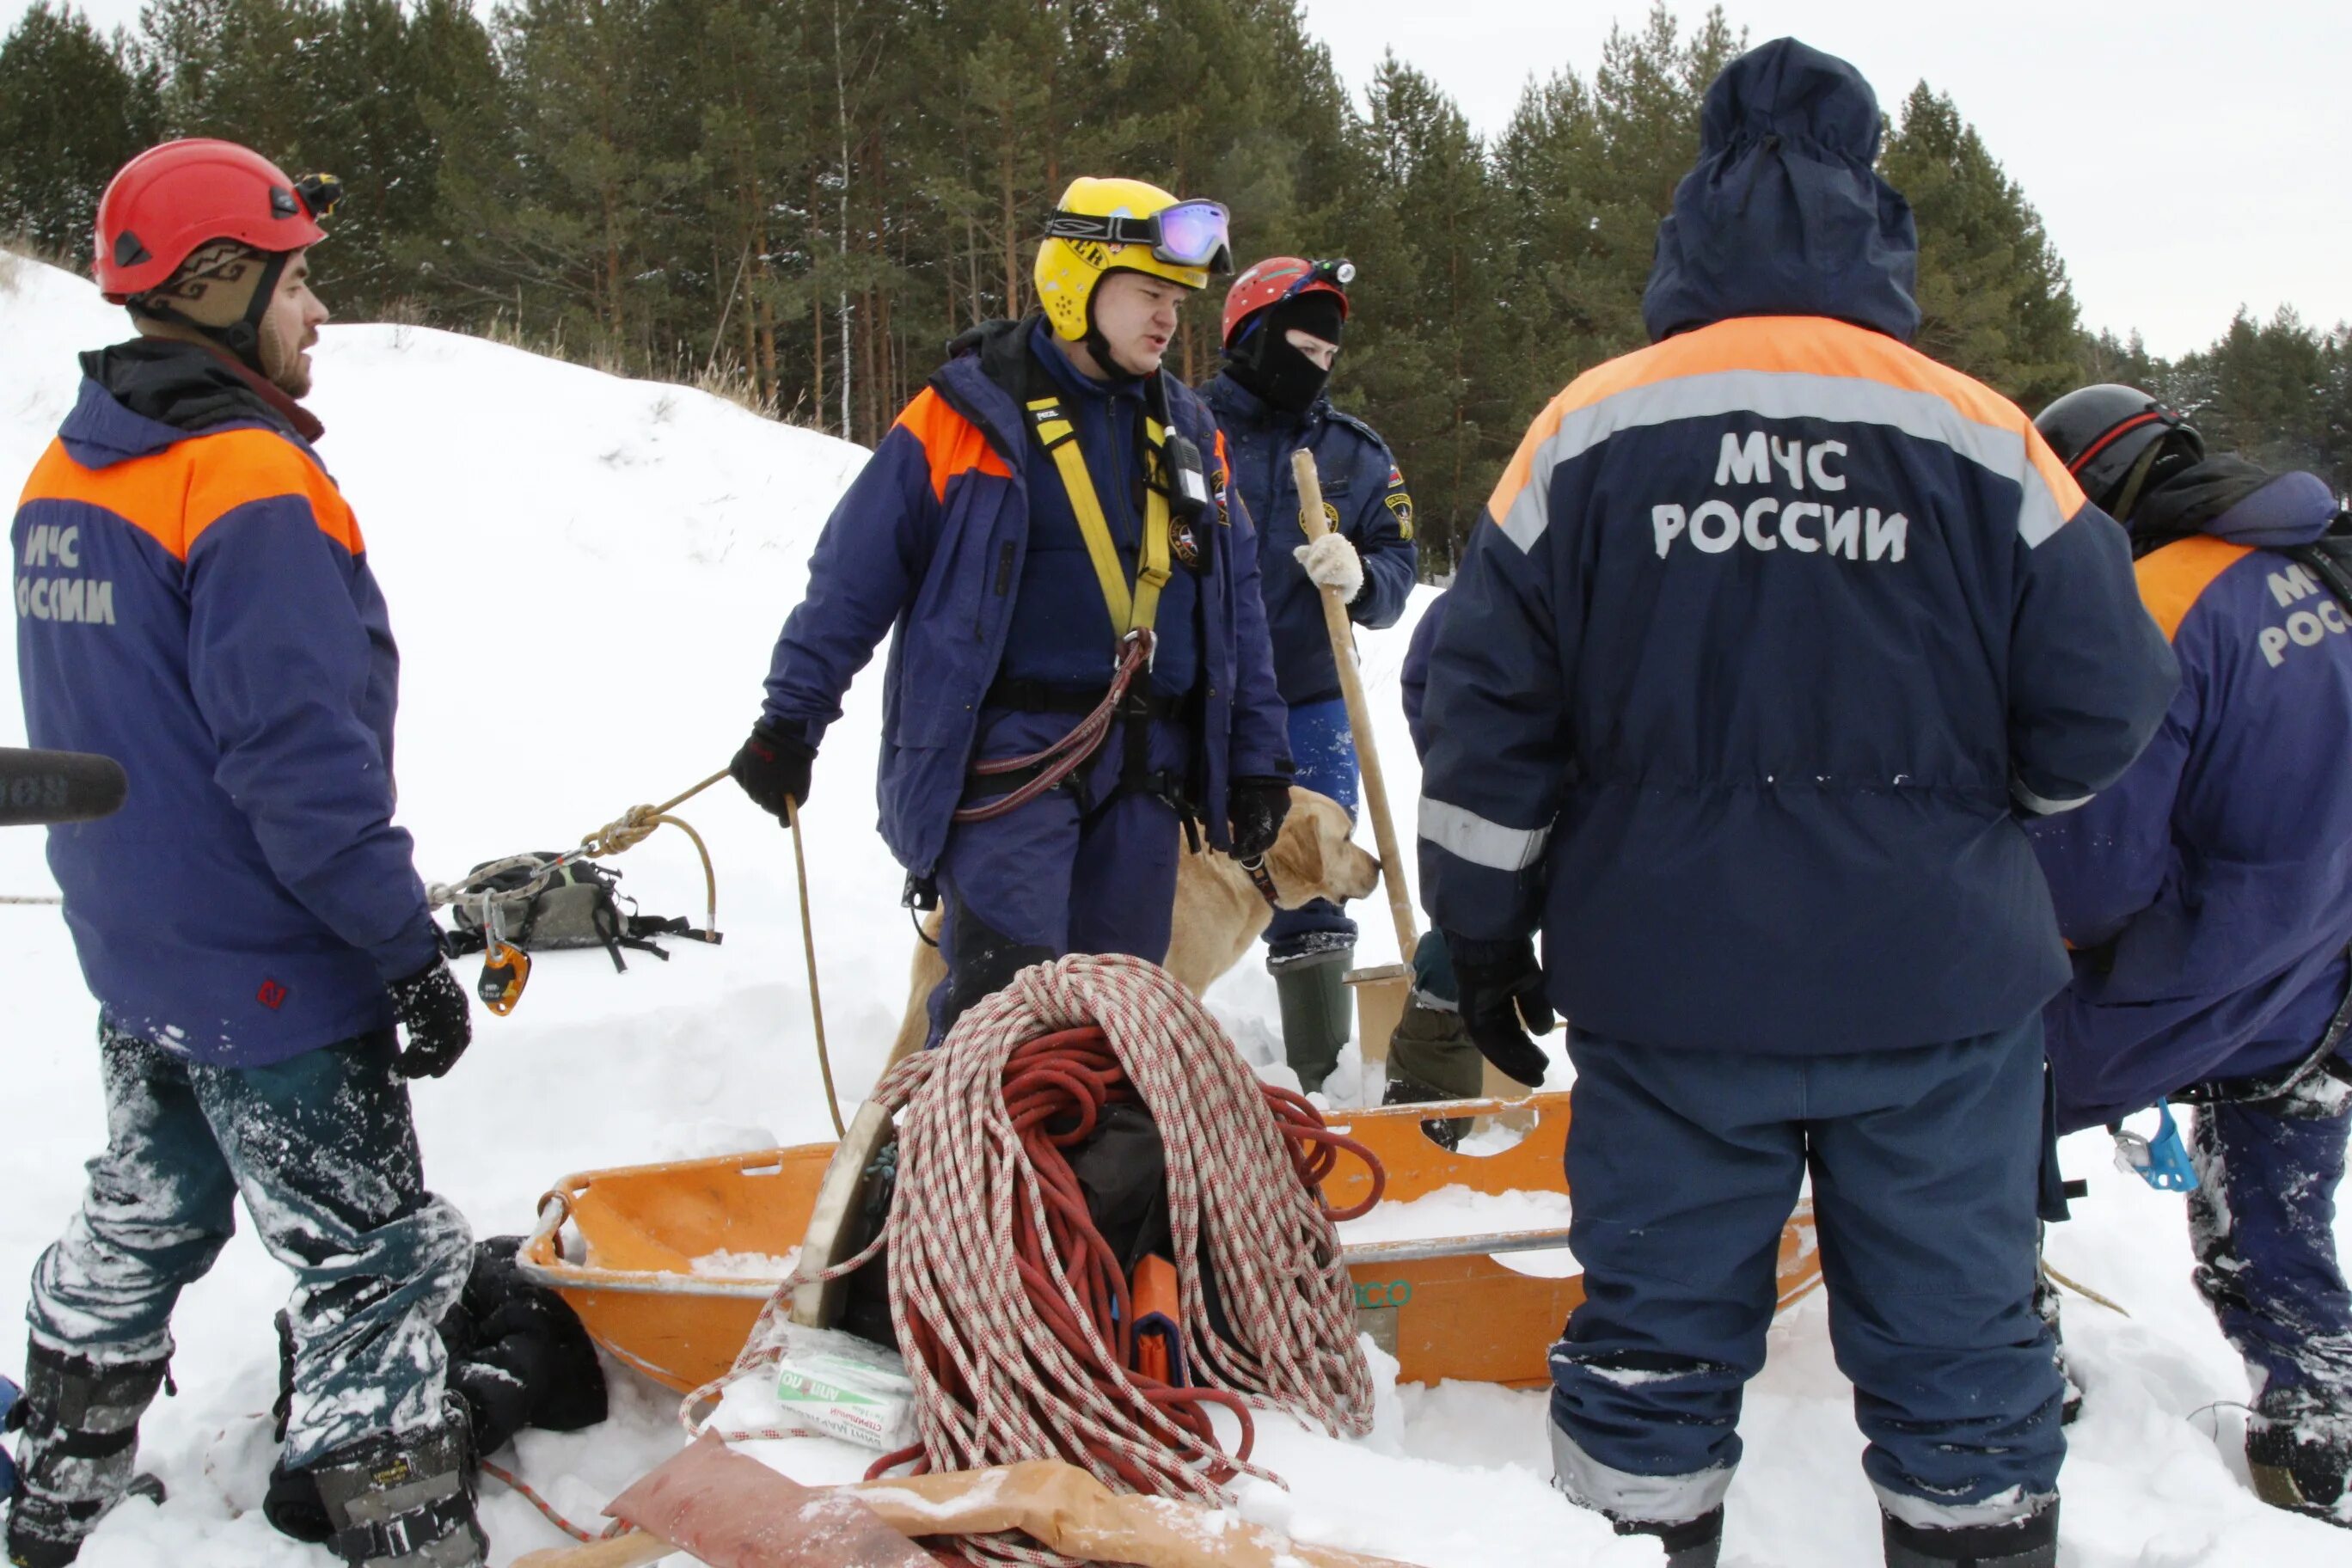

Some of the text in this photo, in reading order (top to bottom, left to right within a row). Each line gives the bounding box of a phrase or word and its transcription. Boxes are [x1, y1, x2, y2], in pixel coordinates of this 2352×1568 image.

[1714, 431, 1847, 492] МЧС
[1651, 497, 1908, 563] РОССИИ
[16, 576, 116, 626] ОССИИ
[2266, 563, 2320, 609] М
[2258, 600, 2352, 669] РОС
